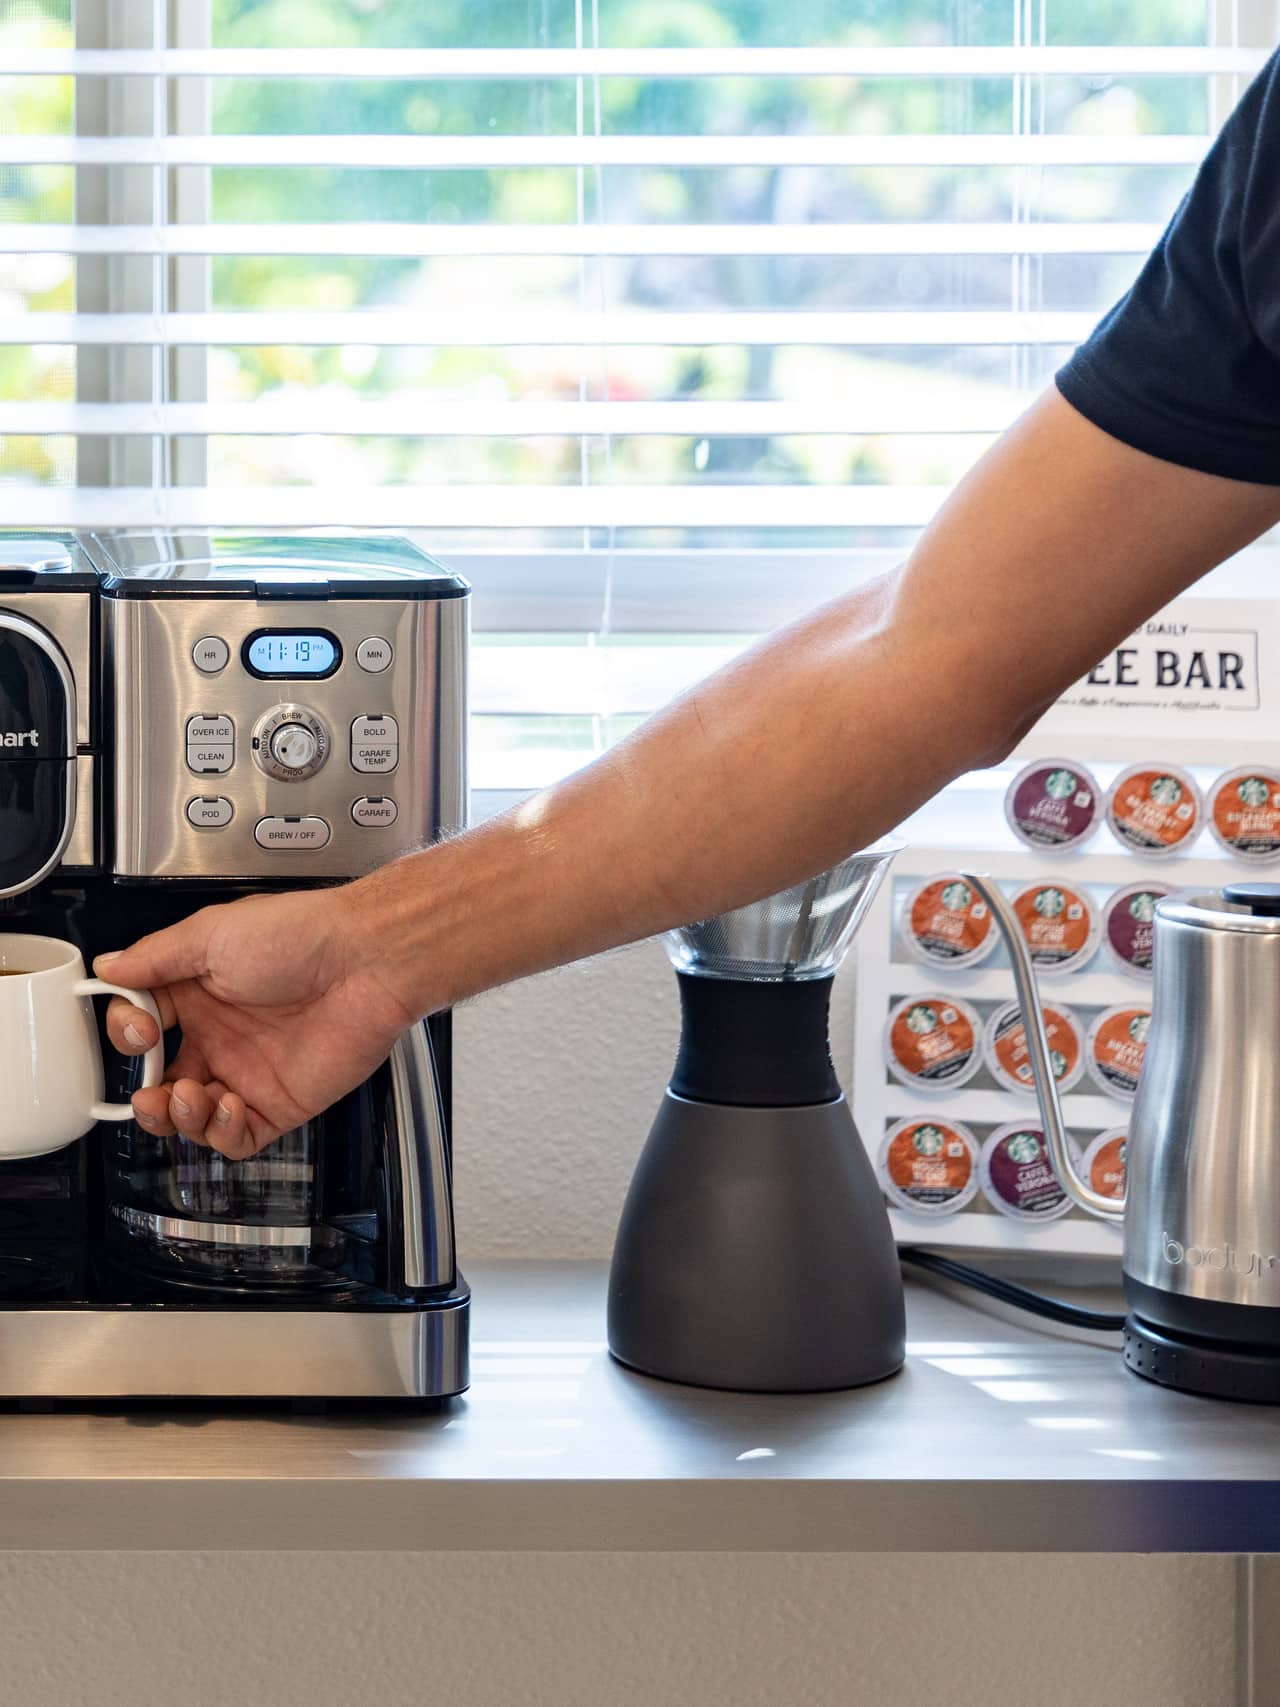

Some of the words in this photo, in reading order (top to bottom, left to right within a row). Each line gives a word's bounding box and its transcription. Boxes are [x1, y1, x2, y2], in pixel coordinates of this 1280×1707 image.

[1146, 623, 1188, 636] DAILY
[204, 650, 216, 659] HR
[268, 642, 310, 662] 11:19
[366, 650, 383, 659] MIN
[1156, 650, 1246, 690] BAR
[281, 712, 304, 720] BREW
[192, 728, 213, 736] OVER
[214, 728, 230, 736] ICE
[363, 728, 386, 736] BOLD
[198, 752, 225, 761] CLEAN
[359, 750, 392, 758] CARAFE
[364, 758, 387, 766] TEMP
[202, 810, 220, 818] POD
[358, 808, 391, 818] CARAFE
[268, 831, 292, 840] BREW
[300, 831, 317, 840] OFF
